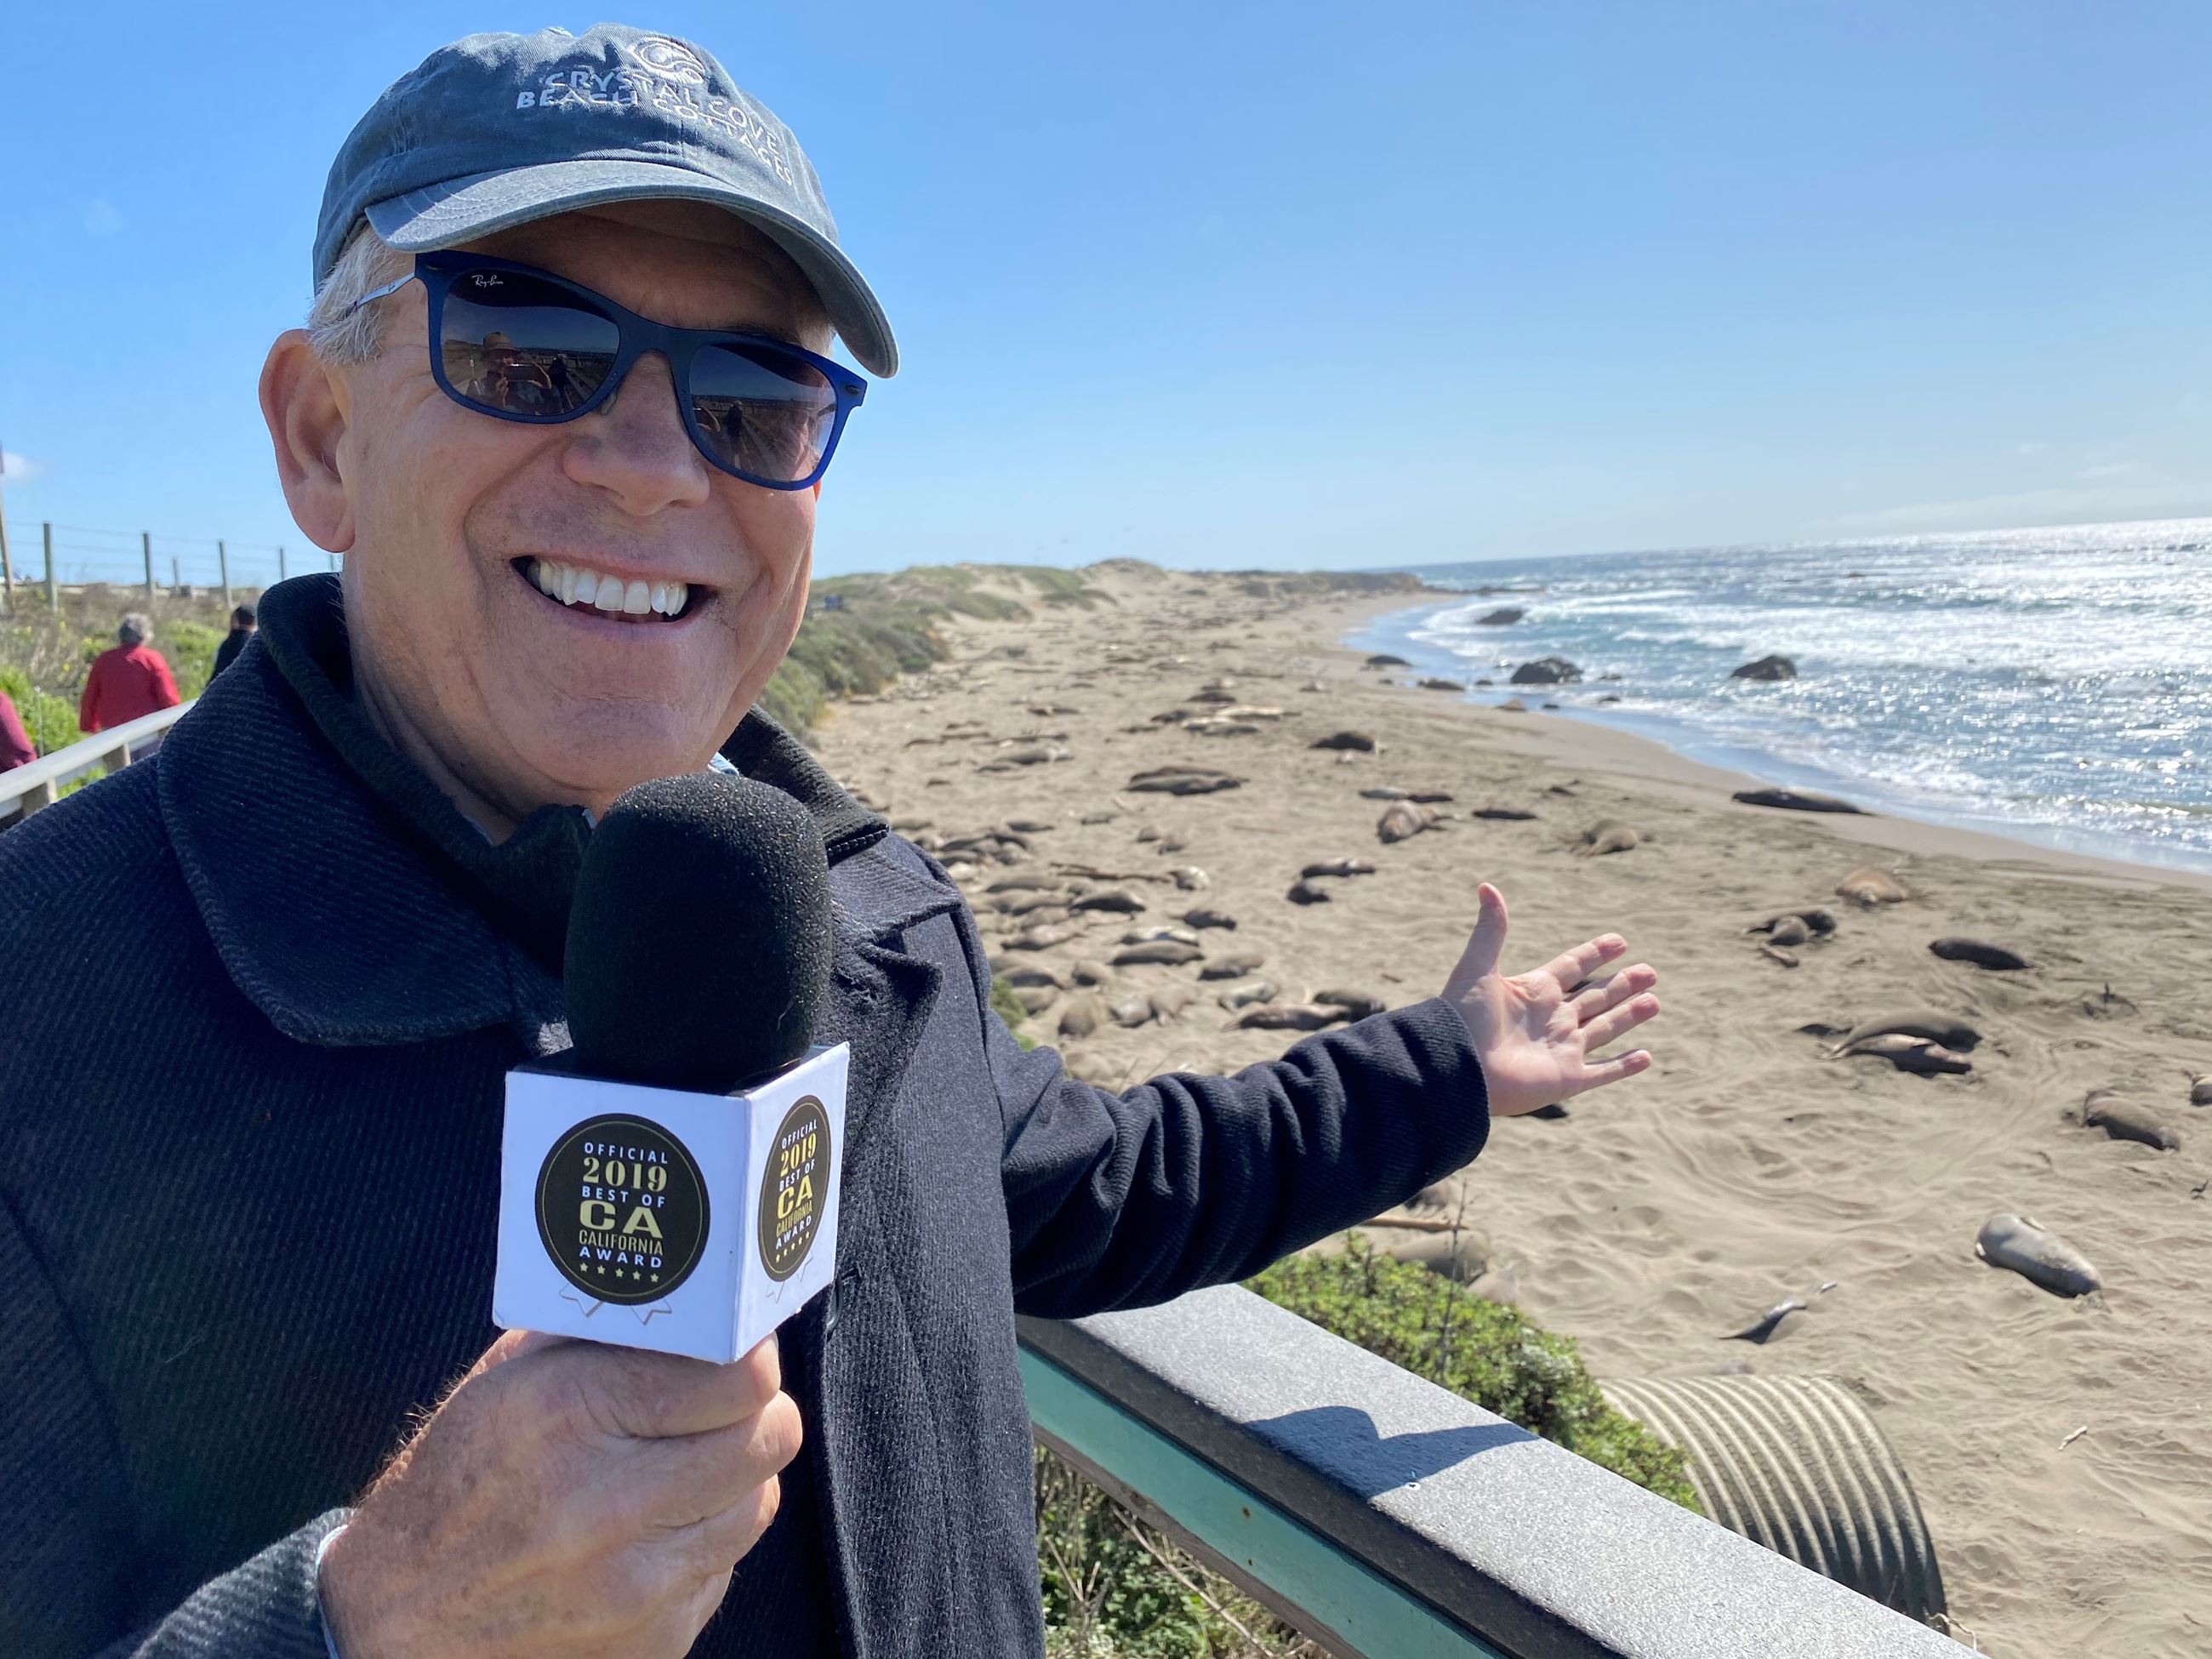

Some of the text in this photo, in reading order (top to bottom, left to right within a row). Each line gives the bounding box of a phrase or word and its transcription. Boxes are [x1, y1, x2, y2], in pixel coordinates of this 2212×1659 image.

[516, 89, 638, 110] BEACH
[544, 70, 782, 153] CRYSTAL COVE
[782, 1120, 817, 1149] OFFICIAL
[584, 1142, 668, 1165] OFFICIAL
[780, 1132, 817, 1177] 2019
[583, 1156, 668, 1192] 2019
[778, 1159, 816, 1192] BEST OF
[582, 1186, 666, 1208] BEST OF
[777, 1175, 813, 1219] CA
[579, 1200, 663, 1239] CA
[776, 1200, 812, 1238] CALIFORNIA
[776, 1216, 812, 1250] AWARD
[579, 1229, 664, 1257] CALIFORNIA
[579, 1246, 662, 1268] AWARD
